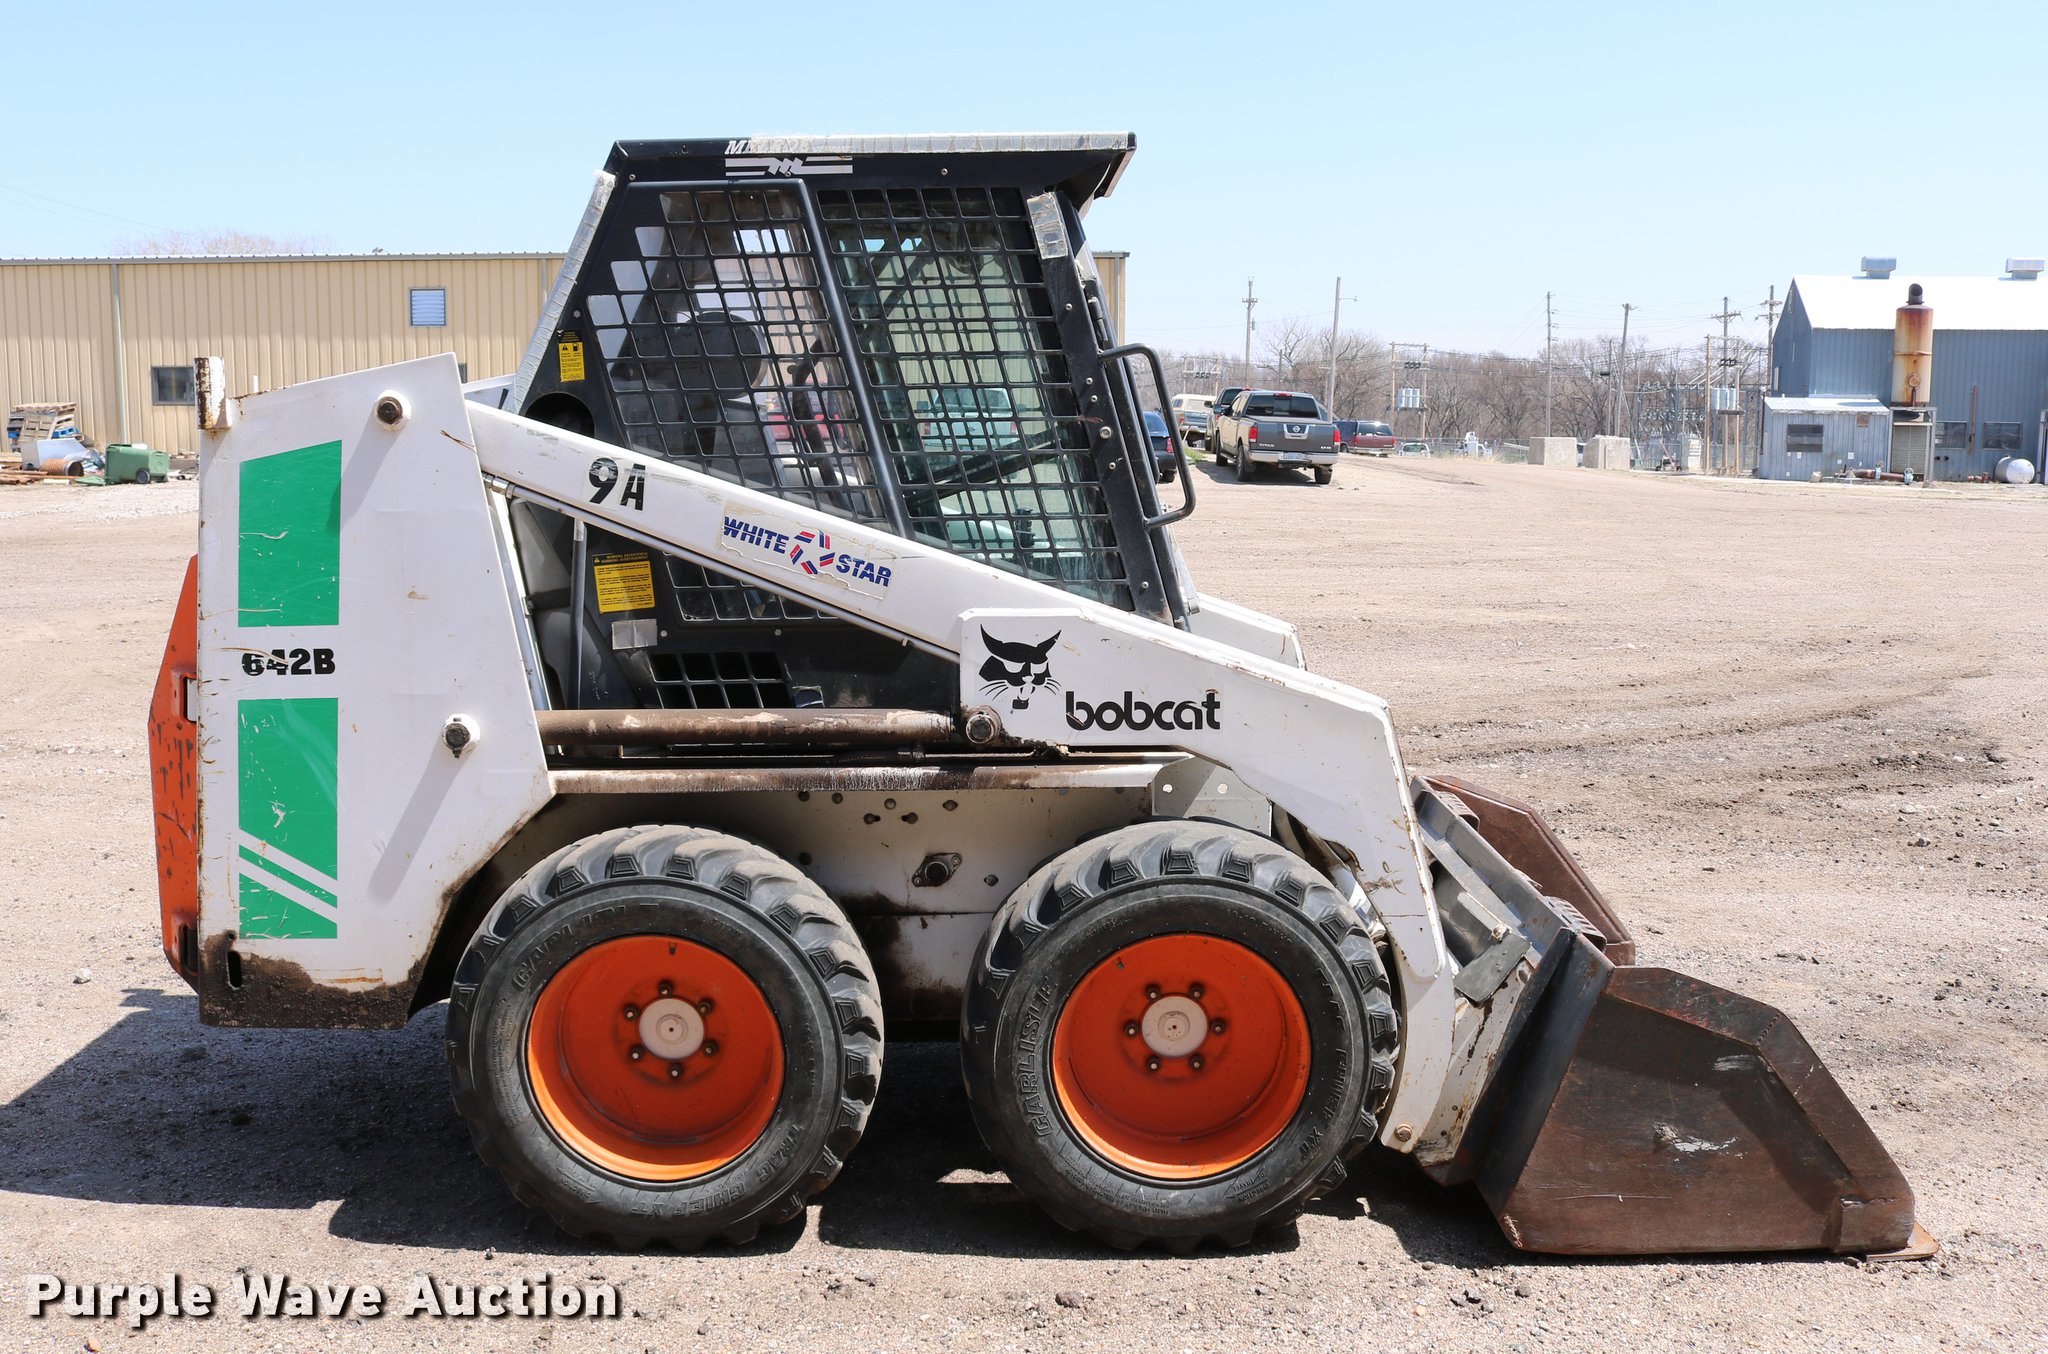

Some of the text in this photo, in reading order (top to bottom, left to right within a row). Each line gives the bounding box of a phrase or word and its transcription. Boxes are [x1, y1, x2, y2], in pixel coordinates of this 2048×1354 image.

[723, 516, 892, 588] WHITE STAR
[241, 648, 336, 676] 642B
[1065, 691, 1221, 731] bobcat
[1015, 976, 1059, 1138] CARLISLE
